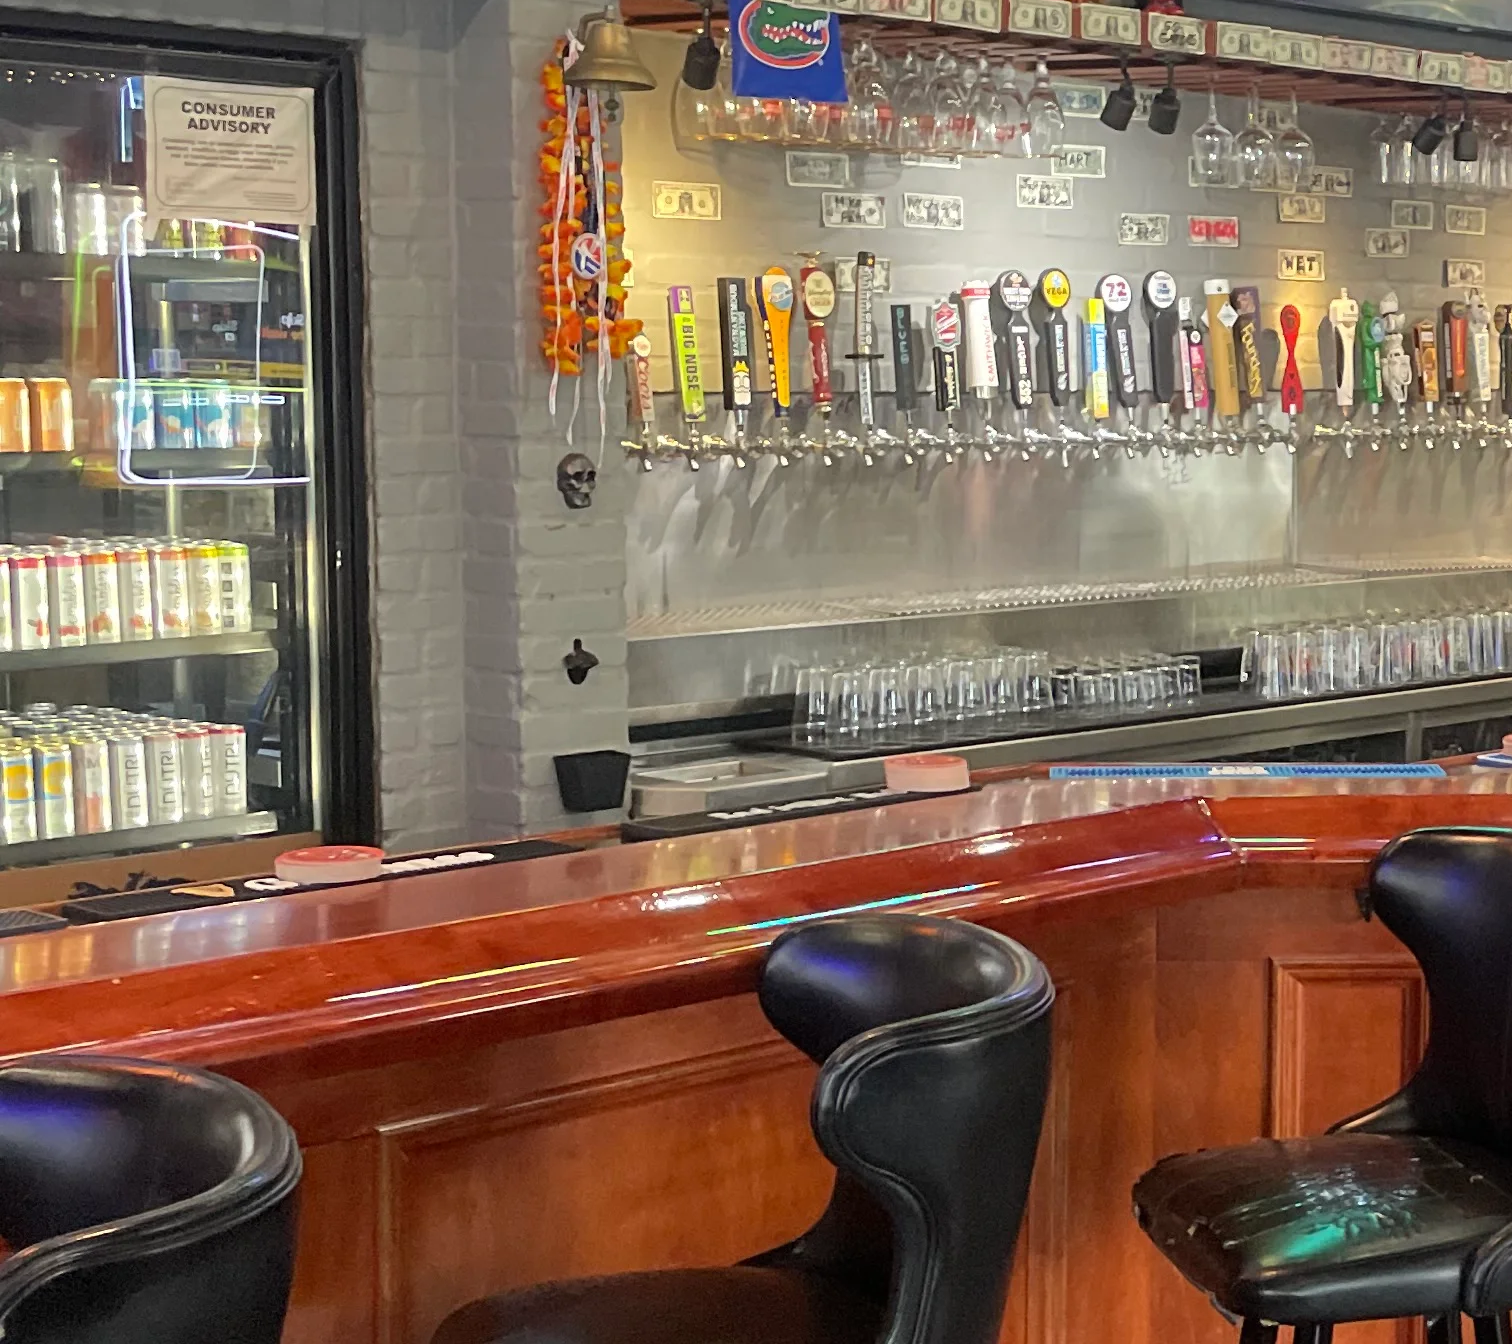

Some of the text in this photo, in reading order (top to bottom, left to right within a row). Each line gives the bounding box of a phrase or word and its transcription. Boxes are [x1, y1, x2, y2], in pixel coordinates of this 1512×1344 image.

[181, 100, 276, 120] CONSUMER
[187, 117, 271, 135] ADVISORY
[1105, 281, 1128, 298] 72
[682, 324, 700, 393] BIG NOSE
